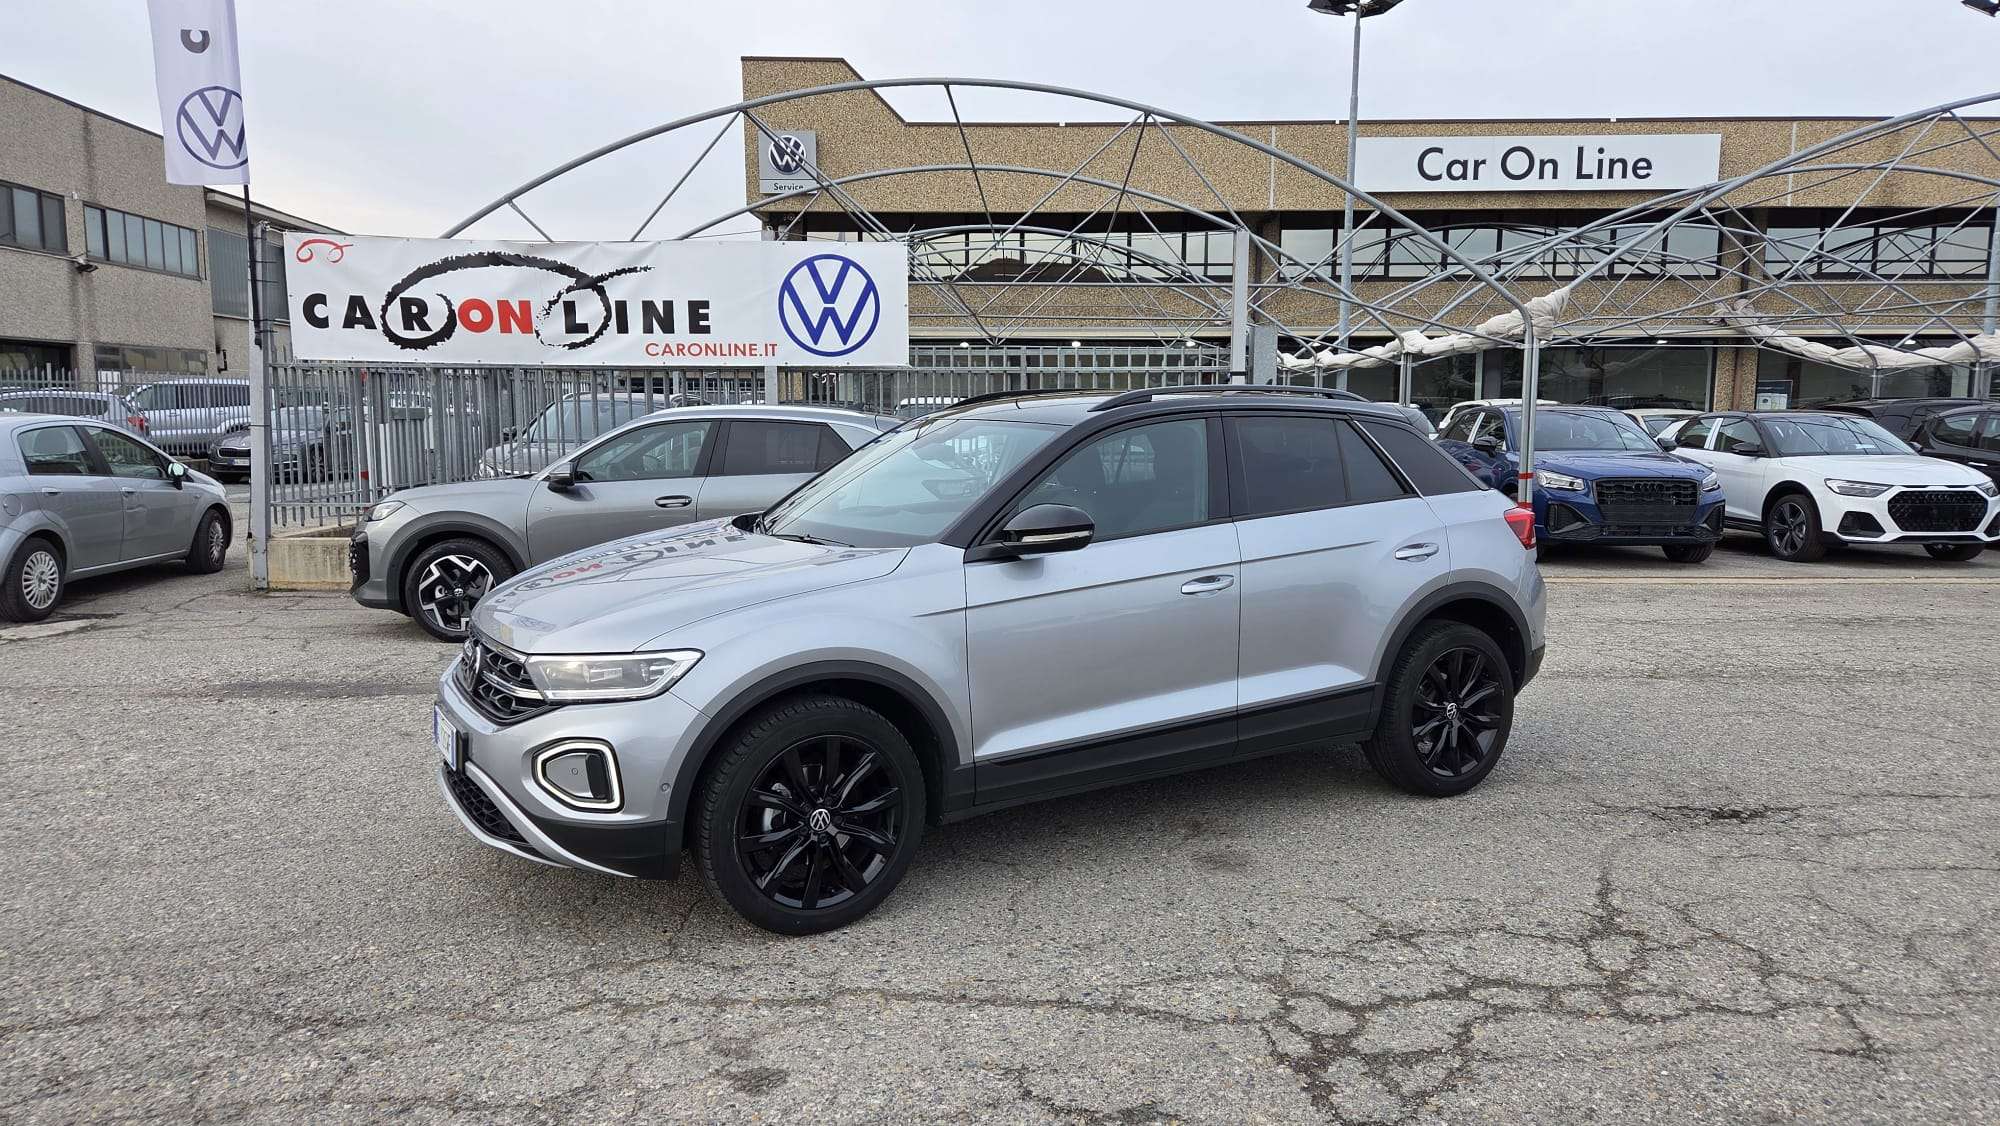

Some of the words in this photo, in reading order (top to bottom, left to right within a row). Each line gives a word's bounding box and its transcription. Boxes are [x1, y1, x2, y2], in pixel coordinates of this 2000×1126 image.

[1417, 146, 1487, 182] Car
[1500, 145, 1559, 181] On
[1575, 146, 1653, 180] Line
[773, 182, 804, 191] Service
[645, 342, 778, 357] CARONLINE.IT
